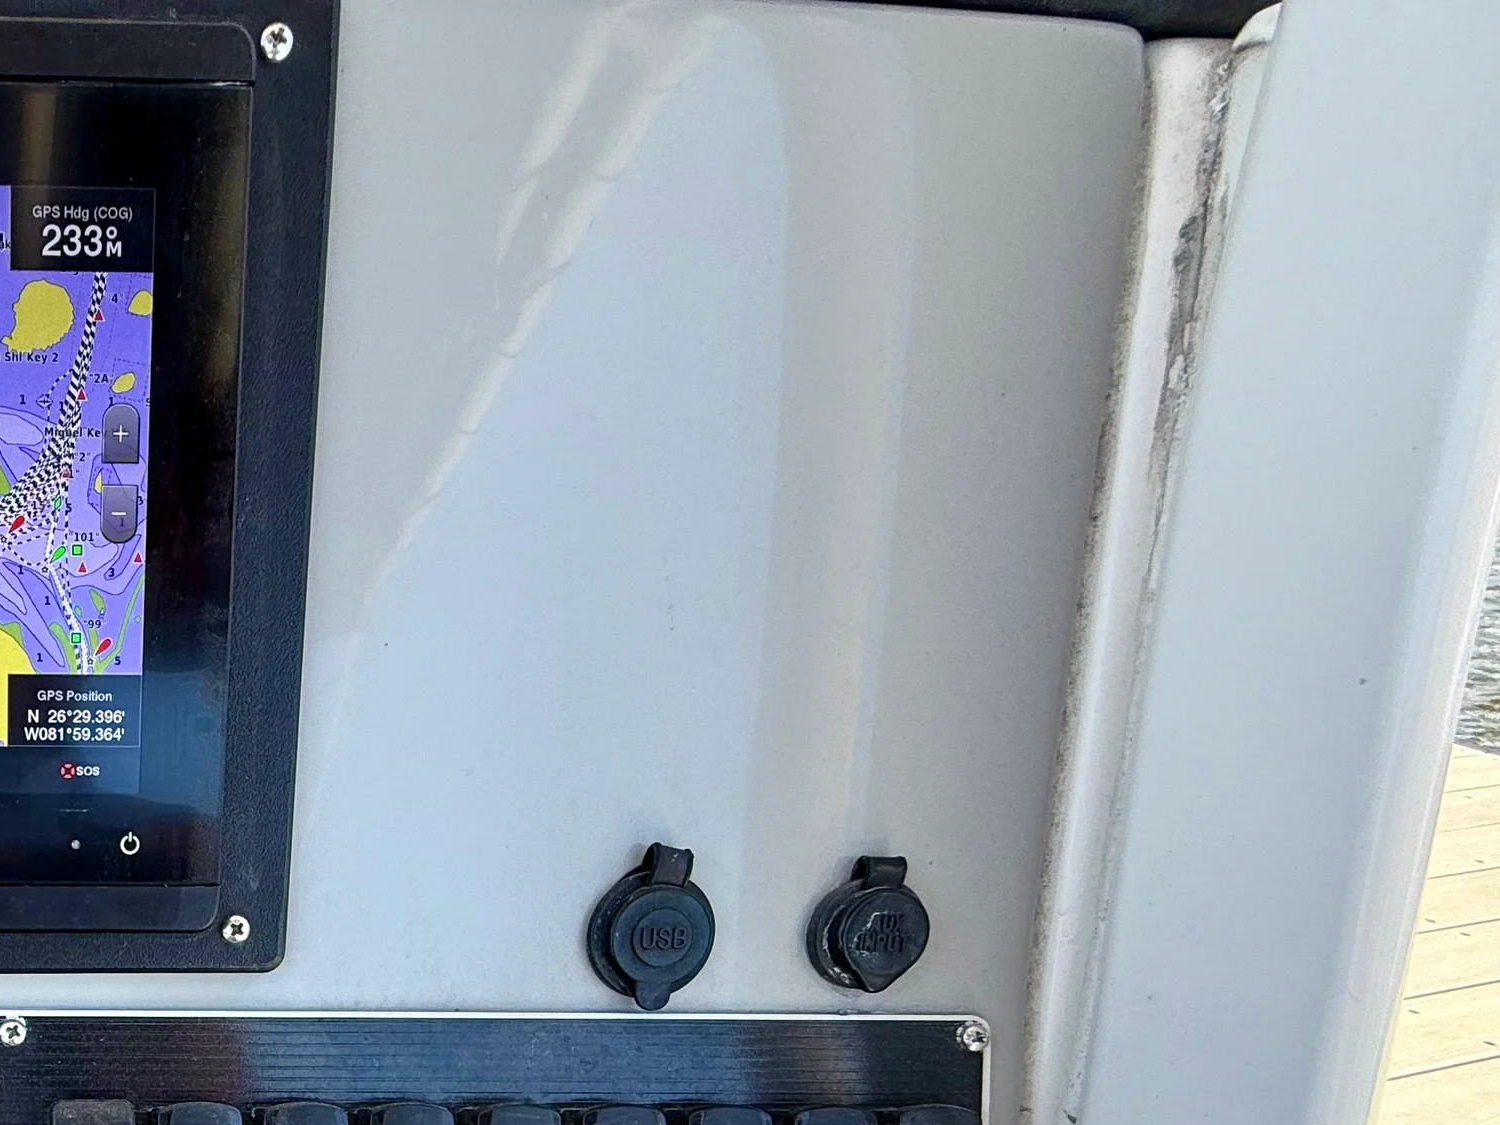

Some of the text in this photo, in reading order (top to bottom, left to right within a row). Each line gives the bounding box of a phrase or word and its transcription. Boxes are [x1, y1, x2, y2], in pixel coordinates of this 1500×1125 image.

[32, 205, 133, 222] GPS Hdg (COG)
[27, 352, 47, 364] Key
[52, 353, 58, 363] 2
[45, 427, 103, 439] Miguel Ke
[37, 653, 43, 662] 1
[114, 656, 121, 665] 5
[37, 691, 113, 702] GPS Position
[27, 710, 125, 724] N 26°29.396'
[76, 766, 100, 776] SOS
[639, 926, 688, 951] USB
